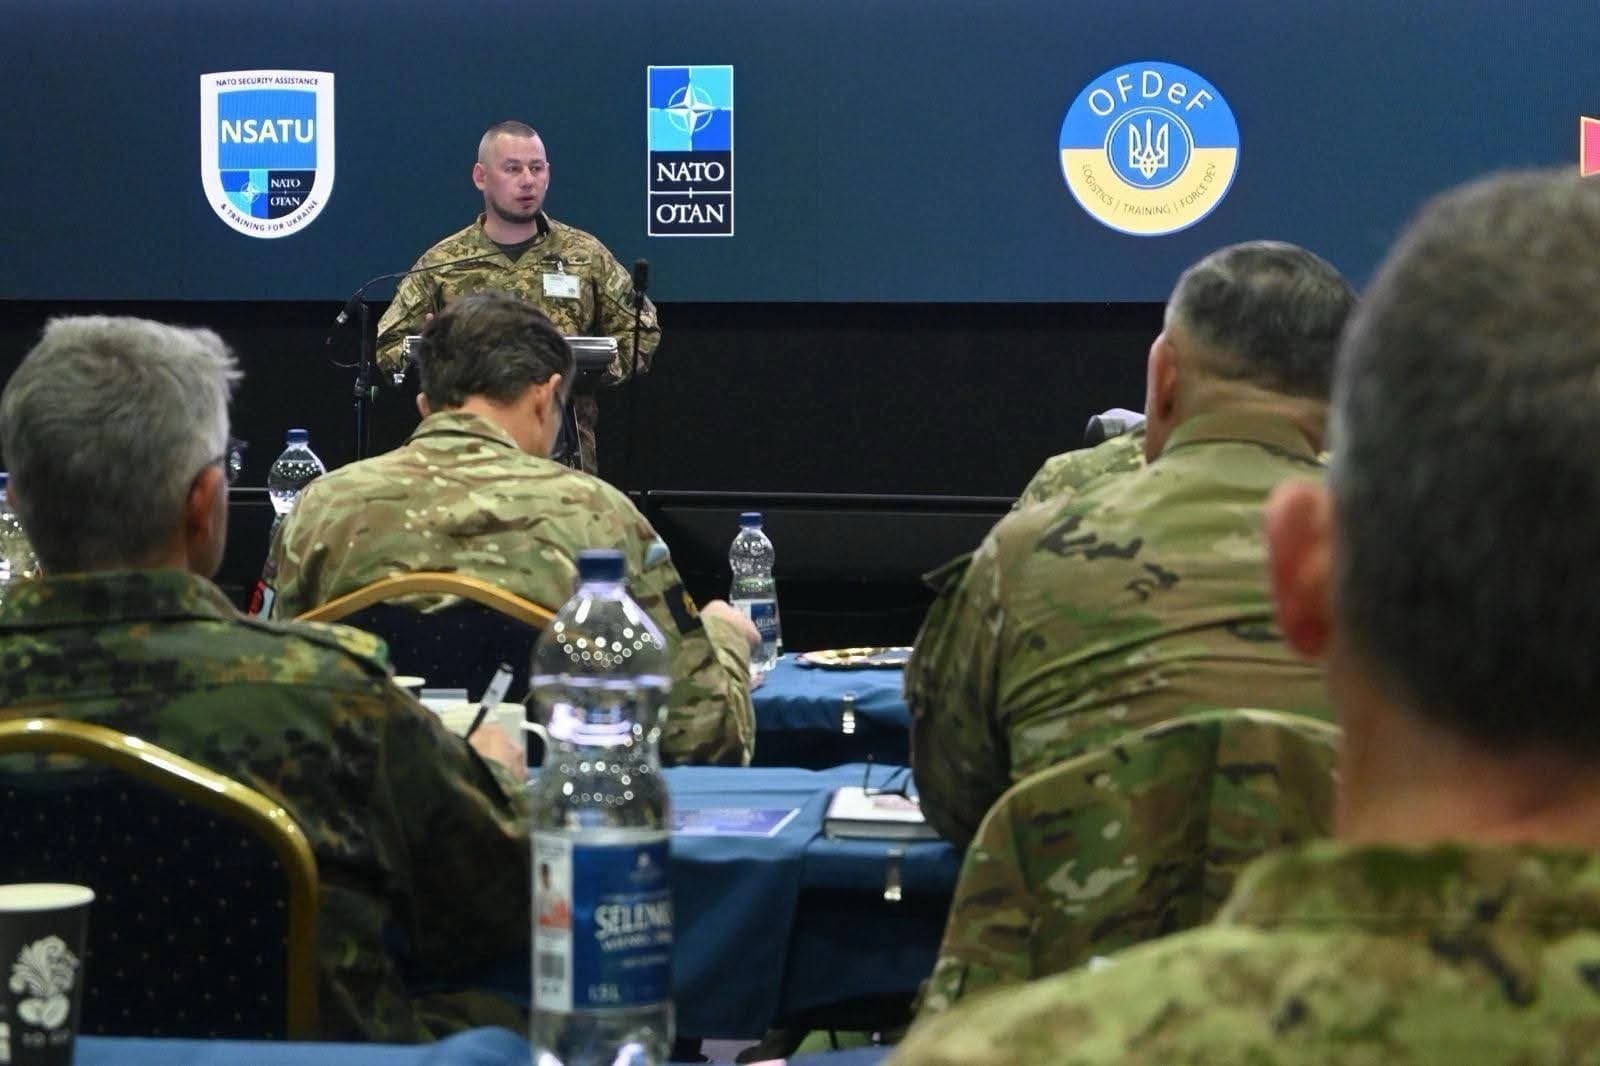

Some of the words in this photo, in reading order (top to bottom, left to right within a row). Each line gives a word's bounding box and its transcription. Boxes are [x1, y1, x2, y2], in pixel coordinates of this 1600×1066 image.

[238, 77, 273, 85] SECURITY
[274, 77, 318, 86] ASSISTANCE
[1088, 70, 1213, 116] OFDeF
[221, 119, 314, 144] NSATU
[656, 161, 725, 182] NATO
[270, 178, 301, 188] NATO
[1081, 162, 1113, 206] LOGISTICS
[1123, 203, 1171, 216] TRAINING
[1180, 184, 1207, 208] FORCE
[1203, 163, 1216, 185] DEV
[270, 197, 301, 207] OTAN
[226, 209, 266, 232] TRAINING
[267, 223, 285, 232] FOR
[286, 200, 319, 228] UKRAINE
[656, 203, 725, 224] OTAN
